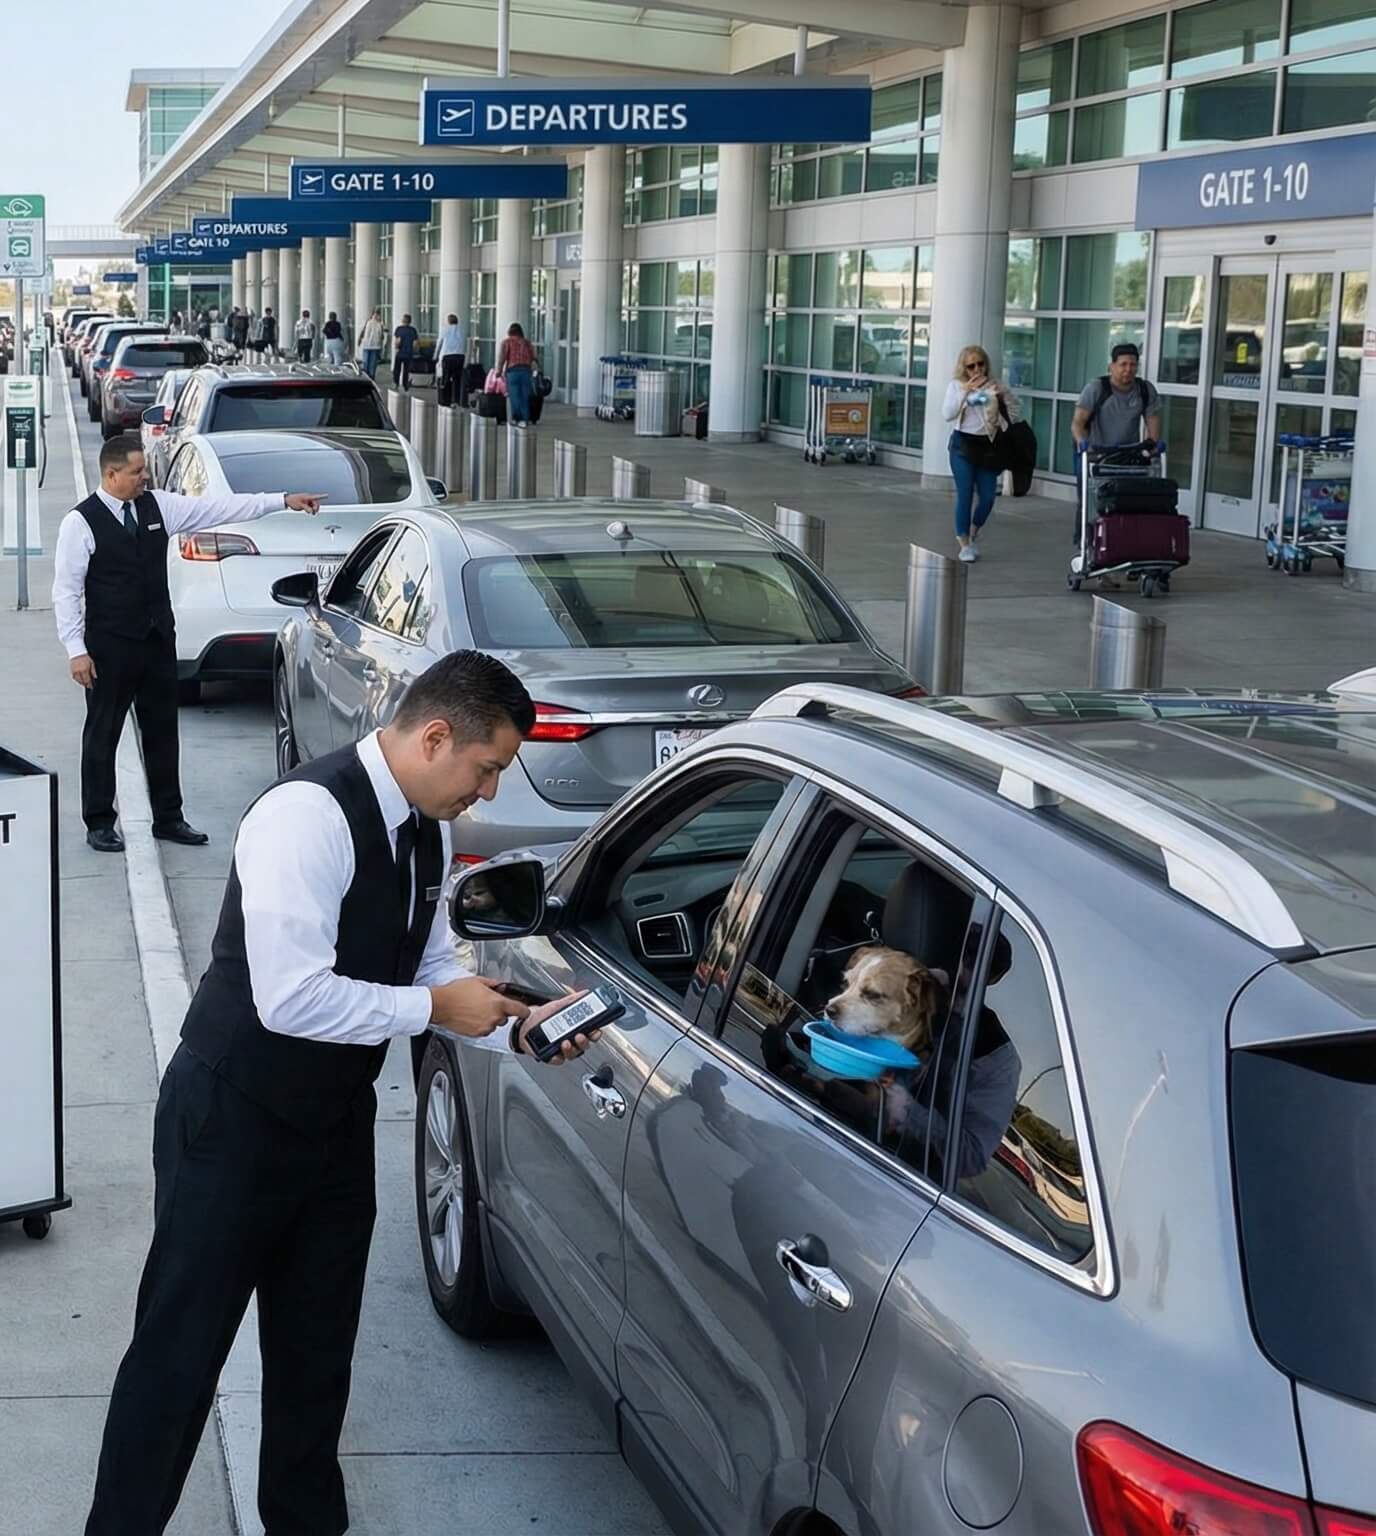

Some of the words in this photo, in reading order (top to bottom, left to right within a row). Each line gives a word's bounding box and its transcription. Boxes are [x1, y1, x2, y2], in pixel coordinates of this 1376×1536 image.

[486, 104, 688, 131] DEPARTURES
[330, 173, 385, 191] GATE
[392, 173, 435, 191] 1-10
[1200, 168, 1256, 208] GATE
[1263, 161, 1309, 203] 1-10
[213, 223, 289, 235] DEPARTURES
